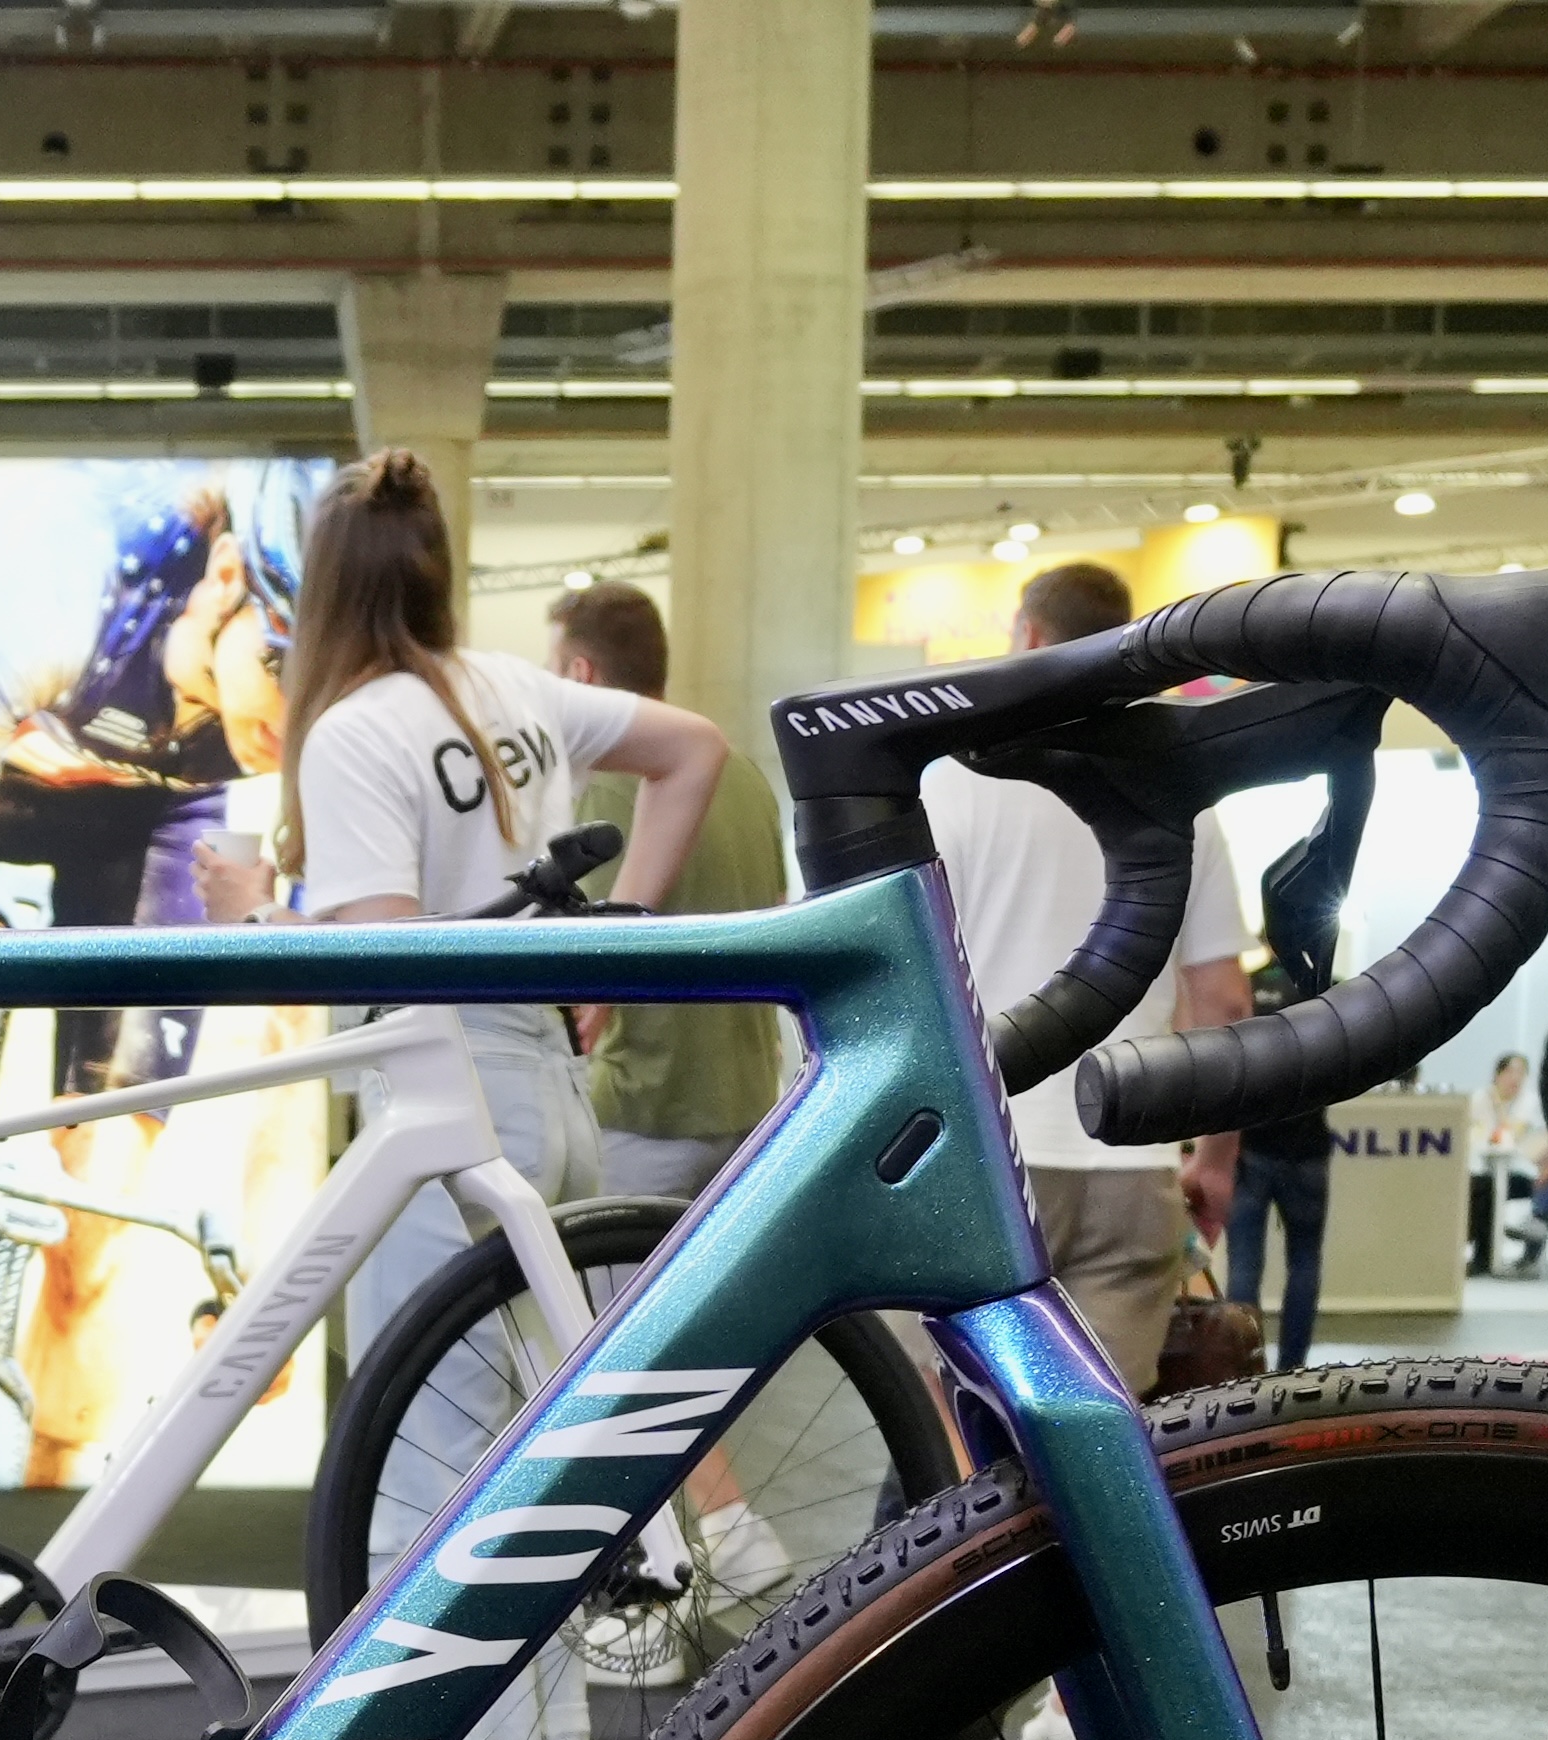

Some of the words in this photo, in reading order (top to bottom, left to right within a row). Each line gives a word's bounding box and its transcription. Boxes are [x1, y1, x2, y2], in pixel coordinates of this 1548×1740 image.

[787, 682, 975, 738] CANYON
[433, 721, 558, 814] Cew
[199, 1233, 357, 1399] CANYON
[1220, 1513, 1282, 1544] SWISS
[1287, 1505, 1322, 1528] DT
